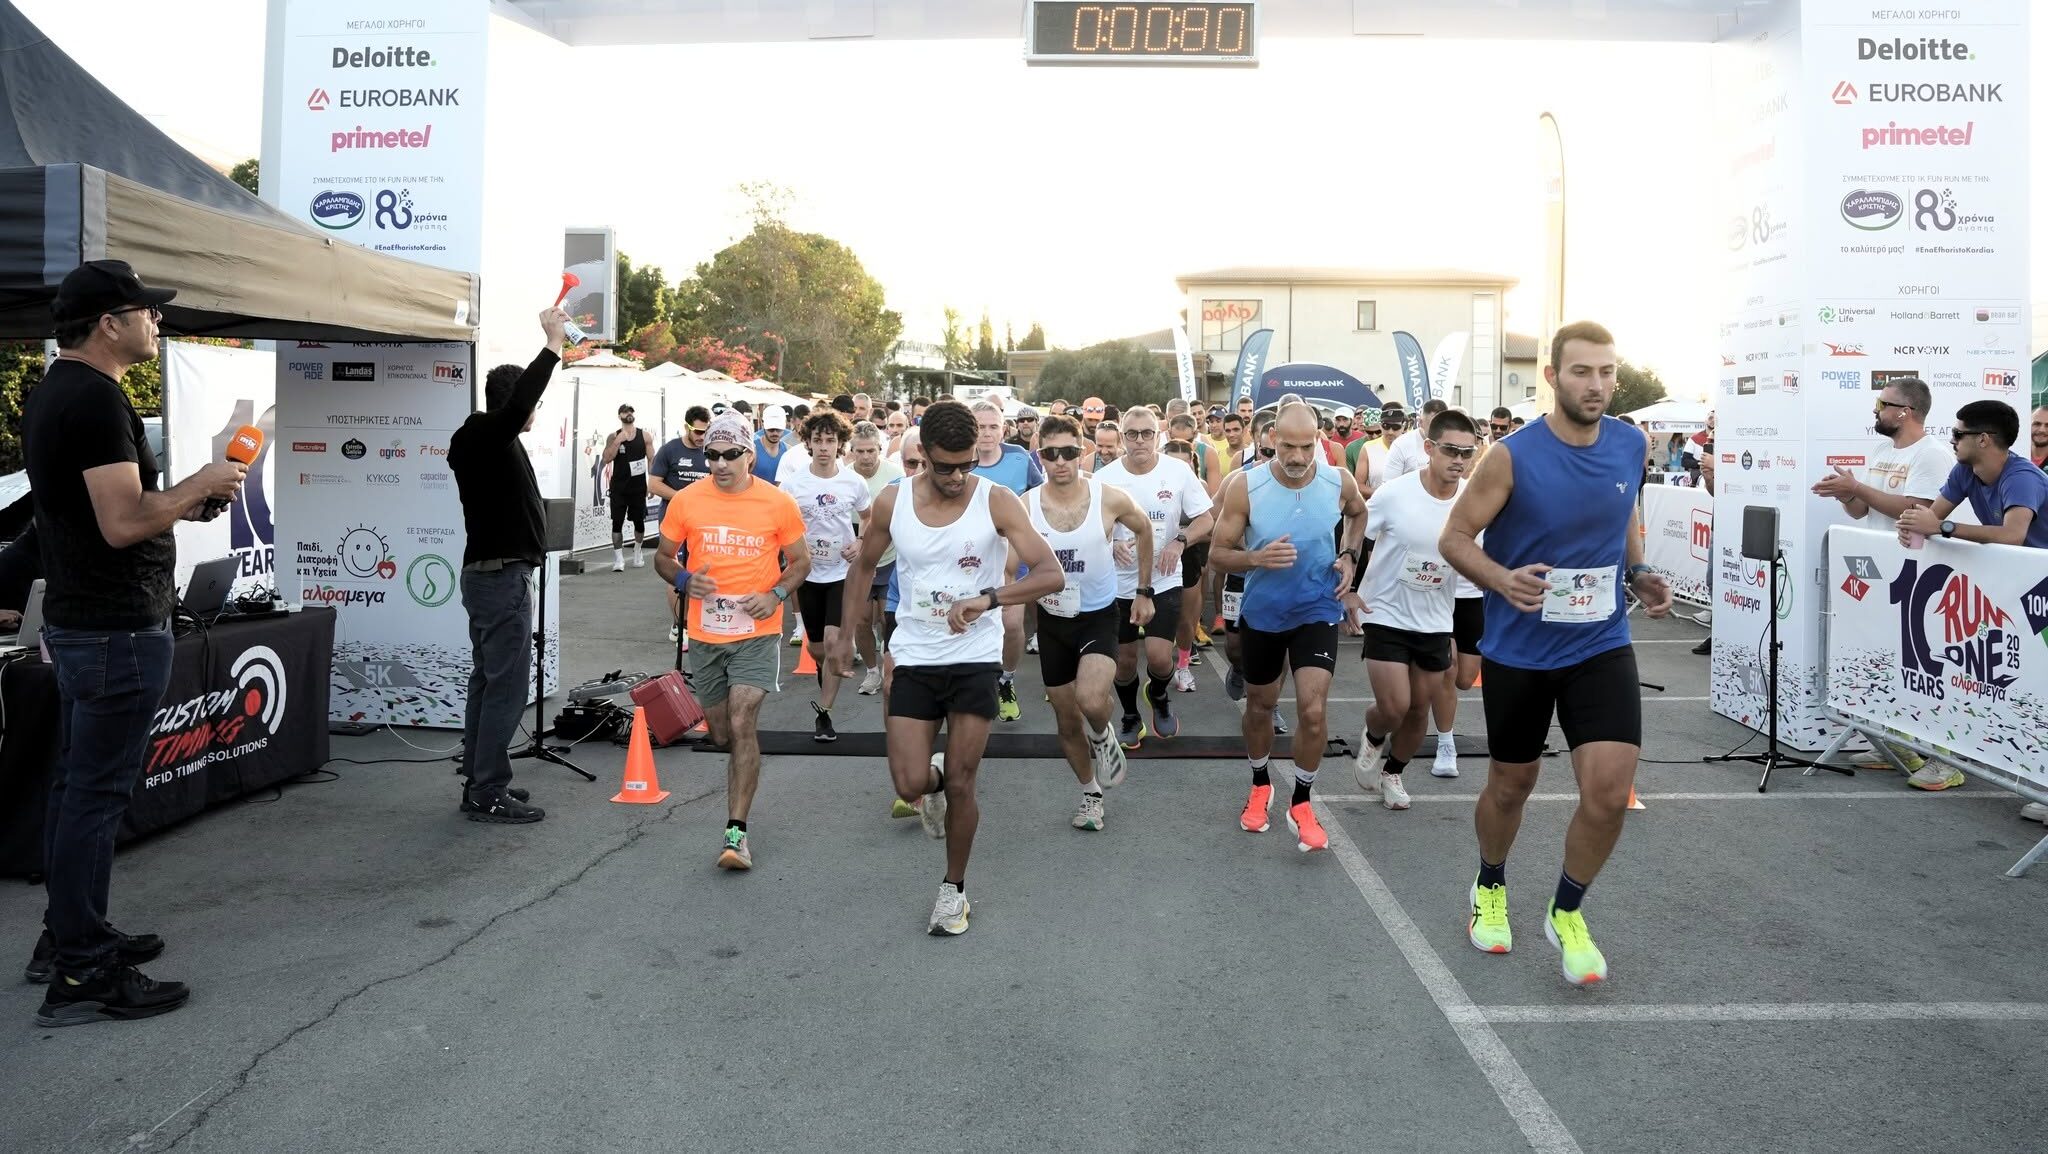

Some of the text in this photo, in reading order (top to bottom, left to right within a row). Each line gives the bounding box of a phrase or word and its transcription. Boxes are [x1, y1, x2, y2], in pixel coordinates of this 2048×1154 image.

[1872, 10, 1960, 20] ΜΕΓΑΛΟΙ ΧΟΡΗΓΟΙ
[346, 19, 426, 30] ΜΕΓΑΛΟΙ ΧΟΡΗΓΟΙ
[1858, 37, 1976, 61] Deloitte.
[332, 46, 437, 68] Deloitte.
[339, 88, 460, 108] EUROBANK
[1869, 83, 2003, 102] EUROBANK
[331, 124, 432, 153] primetel
[1862, 121, 1974, 150] primetel
[387, 176, 401, 184] FUN
[402, 176, 417, 184] RUN
[1927, 175, 1943, 183] FUN
[1944, 175, 1960, 183] RUN
[325, 203, 350, 212] ΚΡΙΣΤΗΣ
[1845, 195, 1899, 210] ΧΑΡΑΛΑΜΠΙΔΗΣ
[1858, 203, 1886, 212] ΚΡΙΣΤΗΣ
[413, 213, 448, 224] χρόνια
[1958, 214, 1995, 225] χρόνια
[1898, 285, 1940, 295] ΧΟΡΗΓΟΙ
[1839, 307, 1875, 316] Universal
[1839, 315, 1854, 323] Life
[1836, 343, 1864, 353] ACS
[1894, 346, 1950, 355] NCR VOYIX
[289, 362, 323, 371] POWER
[435, 364, 464, 379] mix
[304, 370, 323, 380] ADE
[1783, 373, 1798, 388] mix
[1821, 371, 1861, 381] POWER
[1985, 372, 2016, 387] mix
[1283, 379, 1345, 388] EUROBANK
[1839, 380, 1861, 390] ADE
[326, 415, 423, 426] ΥΠΟΣΤΗΡΙΚΤΕΣ ΑΓΩΝΑ
[379, 448, 406, 459] agros
[416, 528, 455, 536] ΣΥΝΕΡΓΑΣΙΑ
[297, 541, 323, 553] Παιδί,
[706, 545, 761, 557] MINE RUN
[296, 554, 338, 566] Διατροφή
[312, 567, 337, 577] Υγεία
[1855, 558, 1869, 578] 5K
[1416, 574, 1433, 582] 207
[1849, 579, 1860, 597] 1K
[1043, 597, 1060, 607] 298
[1569, 595, 1593, 606] 347
[1934, 573, 2017, 644] RUN
[715, 614, 734, 623] 337
[2007, 634, 2020, 652] 20
[1933, 629, 2019, 689] ONE
[2007, 651, 2020, 670] 25
[364, 664, 393, 686] 5K
[1749, 670, 1762, 693] 5K
[1901, 668, 1945, 701] YEARS
[150, 688, 238, 736] CUSTOM
[145, 737, 268, 790] RFID TIMING SOLUTIONS
